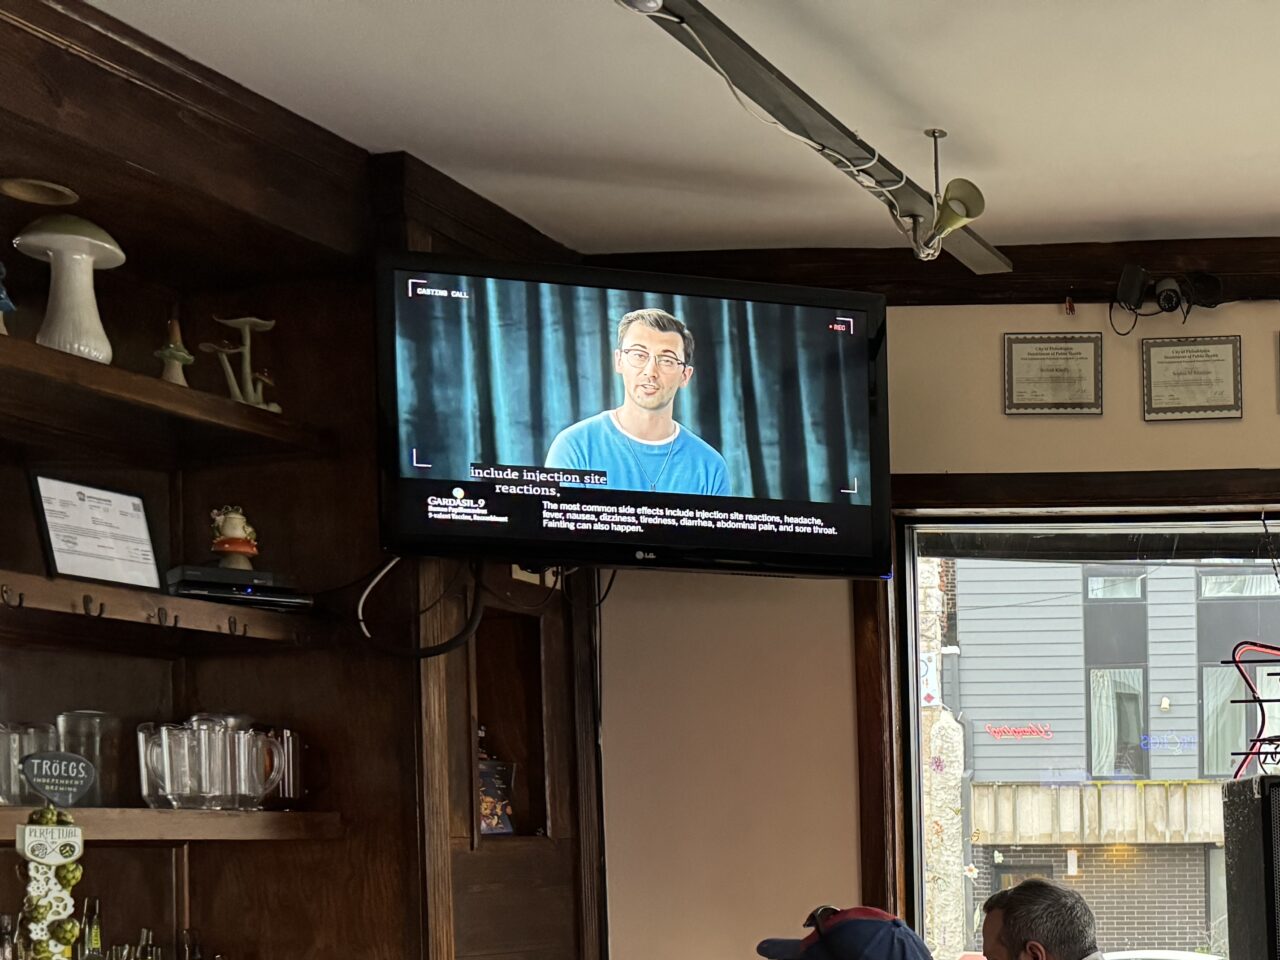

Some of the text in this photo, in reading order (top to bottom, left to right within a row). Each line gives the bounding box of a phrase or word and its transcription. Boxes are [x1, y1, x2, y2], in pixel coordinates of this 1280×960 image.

[451, 291, 469, 299] CALL
[470, 466, 607, 485] include injection site
[542, 501, 823, 526] The most common side effects include injection site reactions, headache,
[542, 510, 838, 535] fever, nausea, dizziness, tiredness, diarrhea, abdominal pain, and sore throat.
[542, 519, 644, 533] Fainting can also happen.
